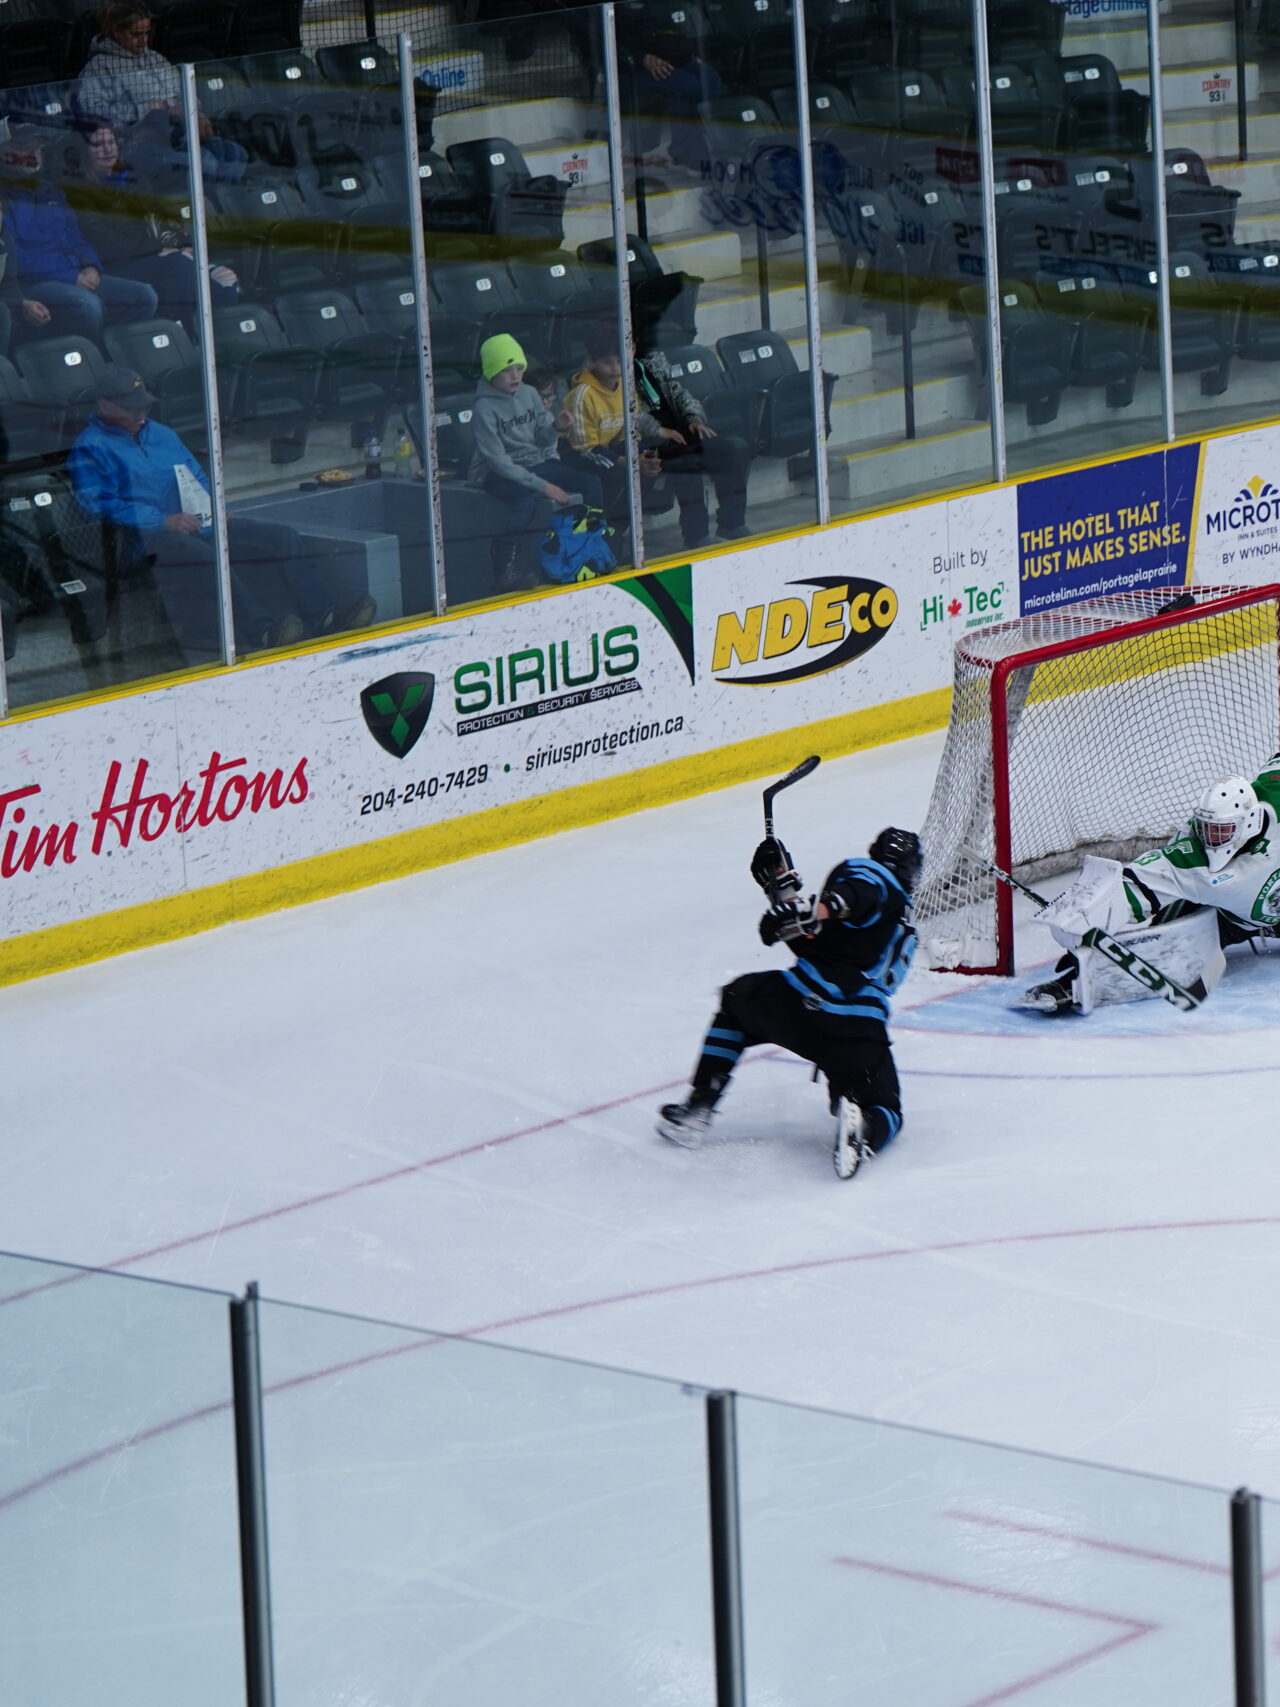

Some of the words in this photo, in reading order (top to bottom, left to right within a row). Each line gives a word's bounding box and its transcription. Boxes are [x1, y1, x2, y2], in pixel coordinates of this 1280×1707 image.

[1202, 79, 1231, 92] COUNTRY
[1021, 527, 1054, 555] THE
[1059, 512, 1114, 545] HOTEL
[1117, 501, 1161, 530] THAT
[1022, 550, 1061, 581] JUST
[1066, 536, 1126, 570] MAKES
[1129, 522, 1187, 556] SENSE.
[1238, 531, 1252, 541] INN
[1260, 526, 1278, 538] SUITES
[933, 553, 966, 575] Built
[970, 548, 988, 569] by
[1222, 551, 1235, 565] BY
[1024, 561, 1178, 611] microtelinn.com/portagelaprairie
[453, 624, 640, 715] SIRIUS
[458, 708, 525, 735] PROTECTION
[537, 691, 588, 714] SECURITY
[590, 679, 639, 701] SERVICES
[360, 763, 488, 817] 204-240-7429
[525, 715, 684, 773] siriusprotection.ca
[91, 751, 309, 857] Hortons
